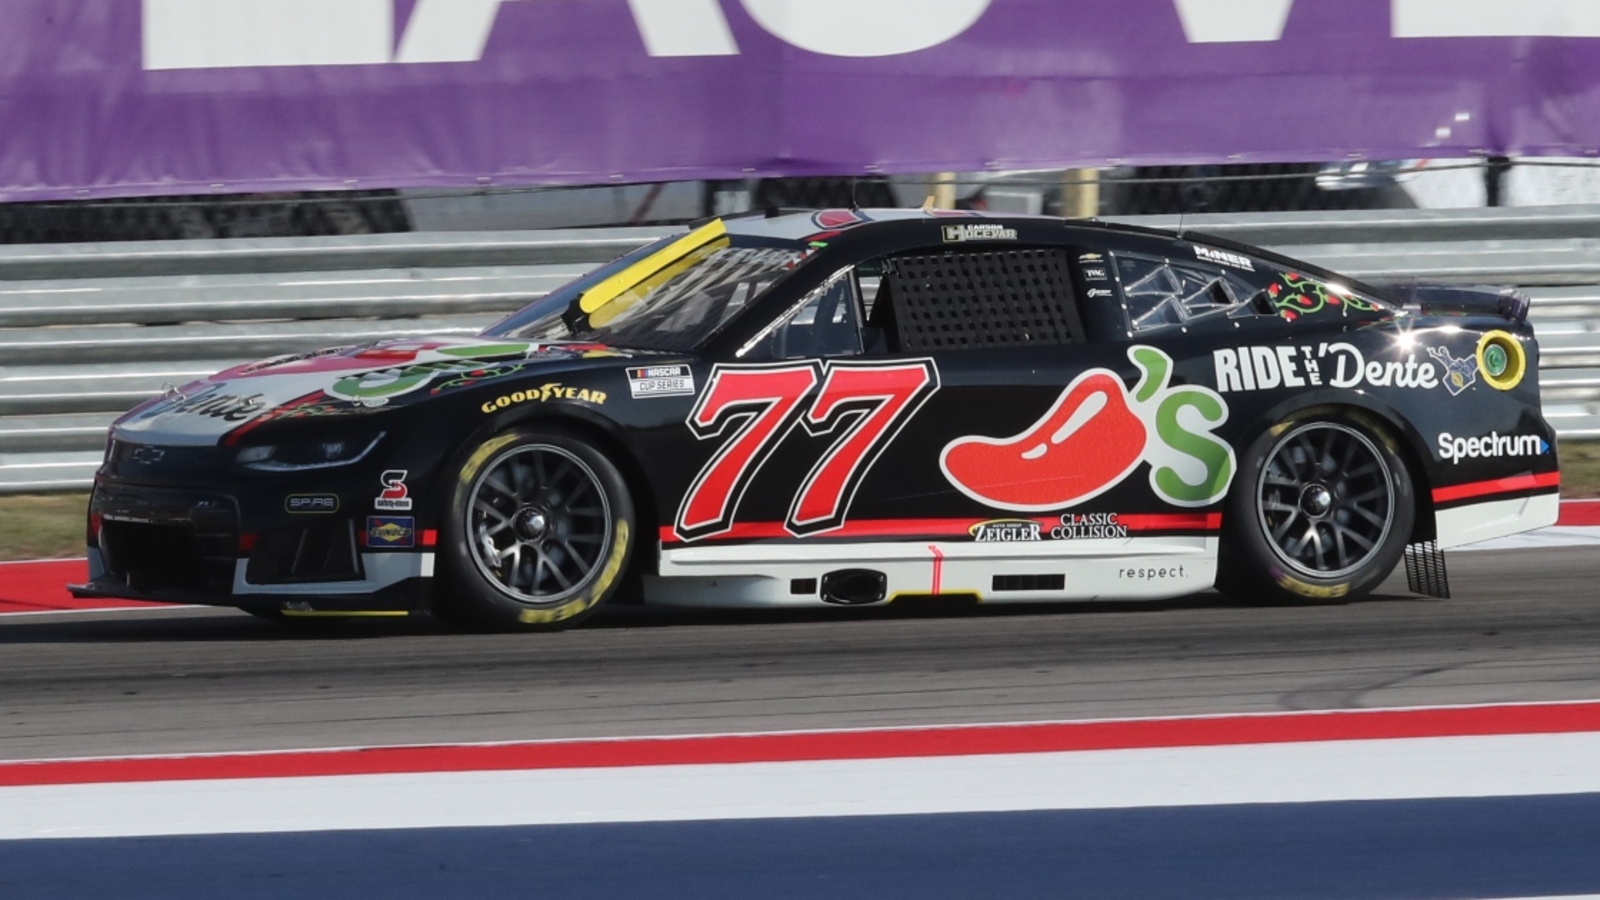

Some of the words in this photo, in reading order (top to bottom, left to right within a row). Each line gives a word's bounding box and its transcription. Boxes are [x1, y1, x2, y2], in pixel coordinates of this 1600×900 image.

[648, 366, 682, 378] NASCAR
[1213, 346, 1306, 392] RIDE
[1301, 346, 1329, 386] THE
[639, 381, 656, 391] CUP
[656, 379, 685, 390] SERIES
[481, 383, 607, 414] GOODYEAR
[673, 357, 941, 542] 77
[1438, 431, 1542, 465] Spectrum
[290, 498, 334, 507] SPRE
[1060, 512, 1118, 527] CLASSIC
[974, 524, 1042, 542] ZEIGLER
[1050, 525, 1128, 540] COLLISION
[1118, 564, 1190, 581] respect.
